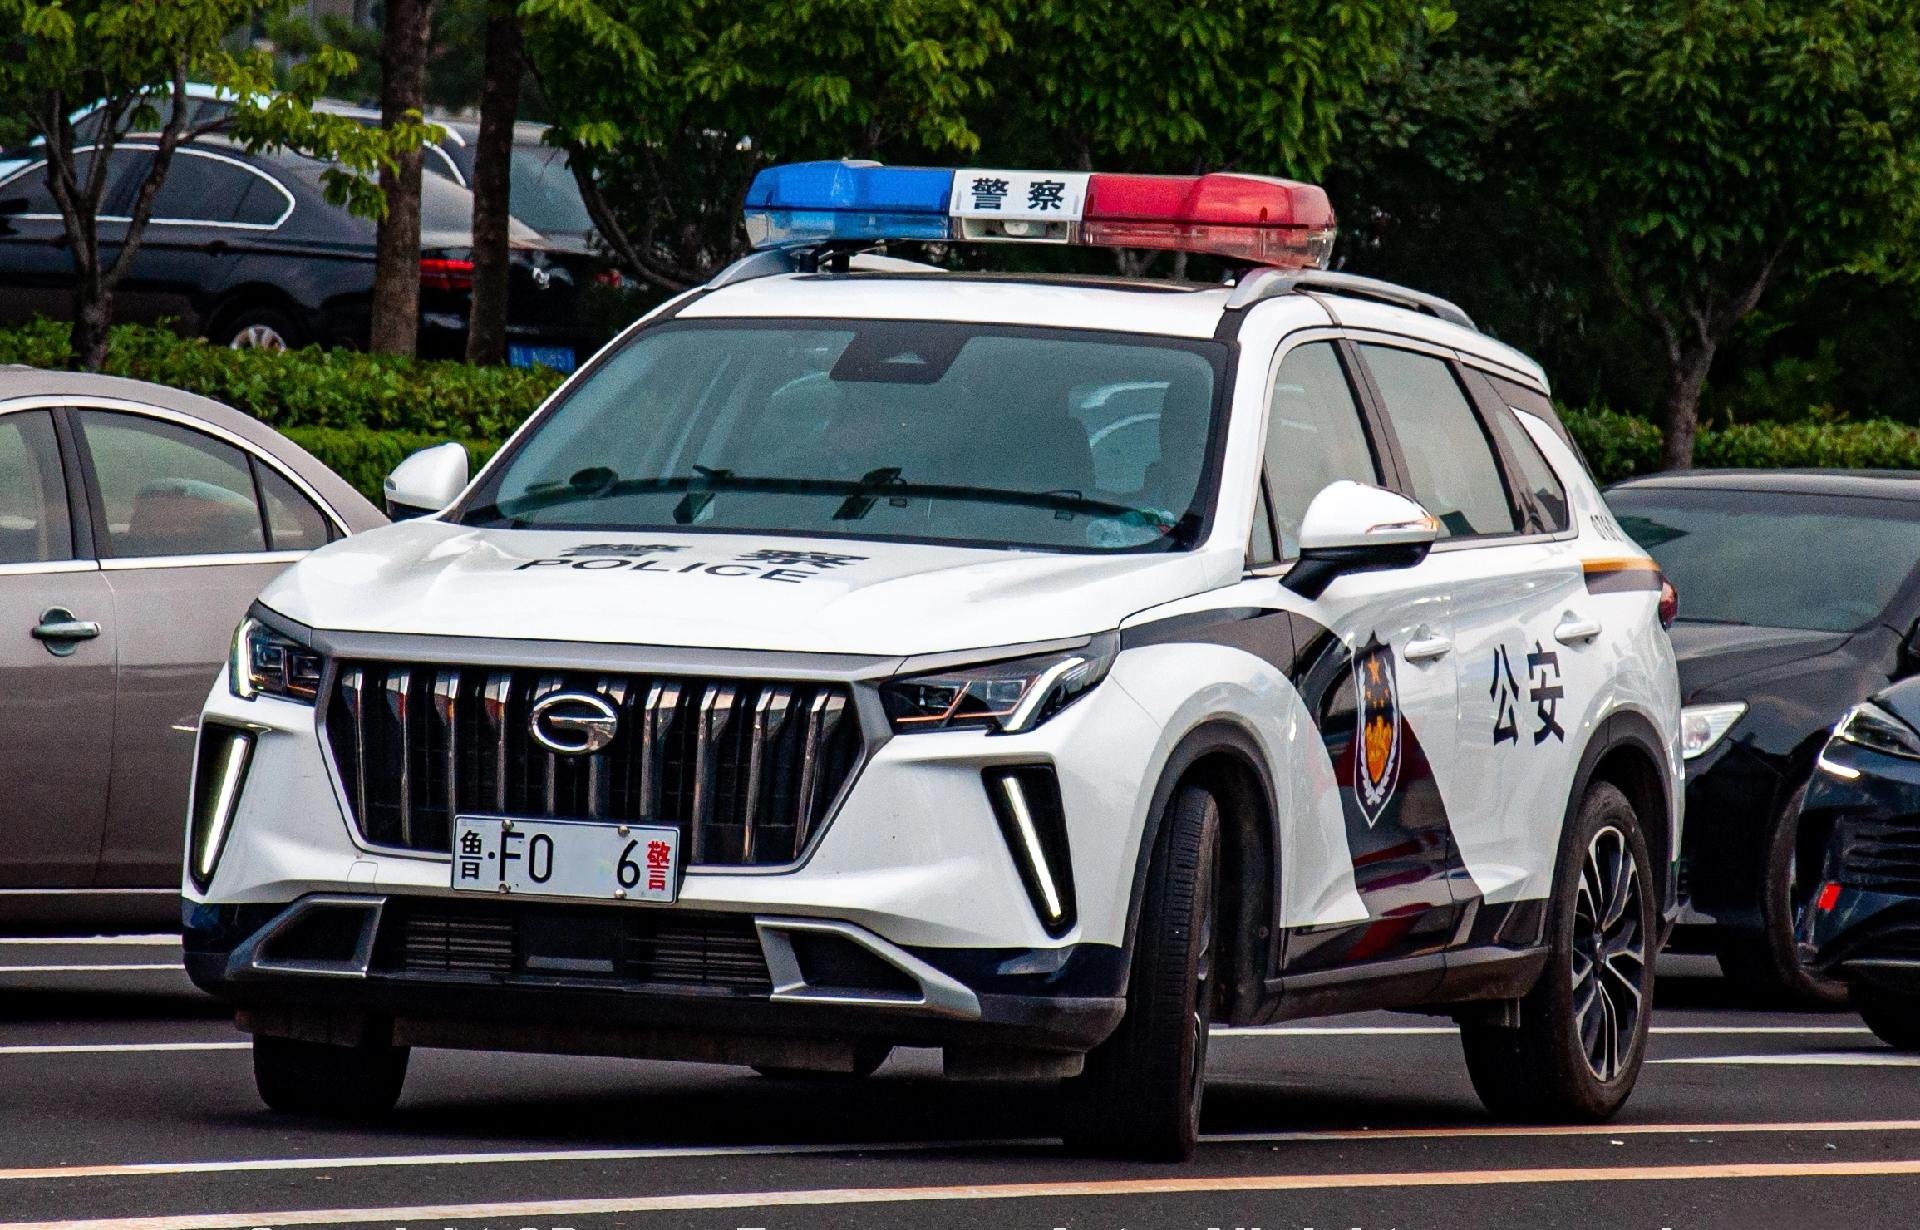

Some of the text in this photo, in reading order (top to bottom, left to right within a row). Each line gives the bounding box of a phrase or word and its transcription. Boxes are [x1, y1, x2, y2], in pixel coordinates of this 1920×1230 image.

[971, 178, 1066, 211] 警察
[559, 543, 870, 569] 警察
[513, 558, 819, 584] POLICE
[1489, 639, 1565, 746] 公安
